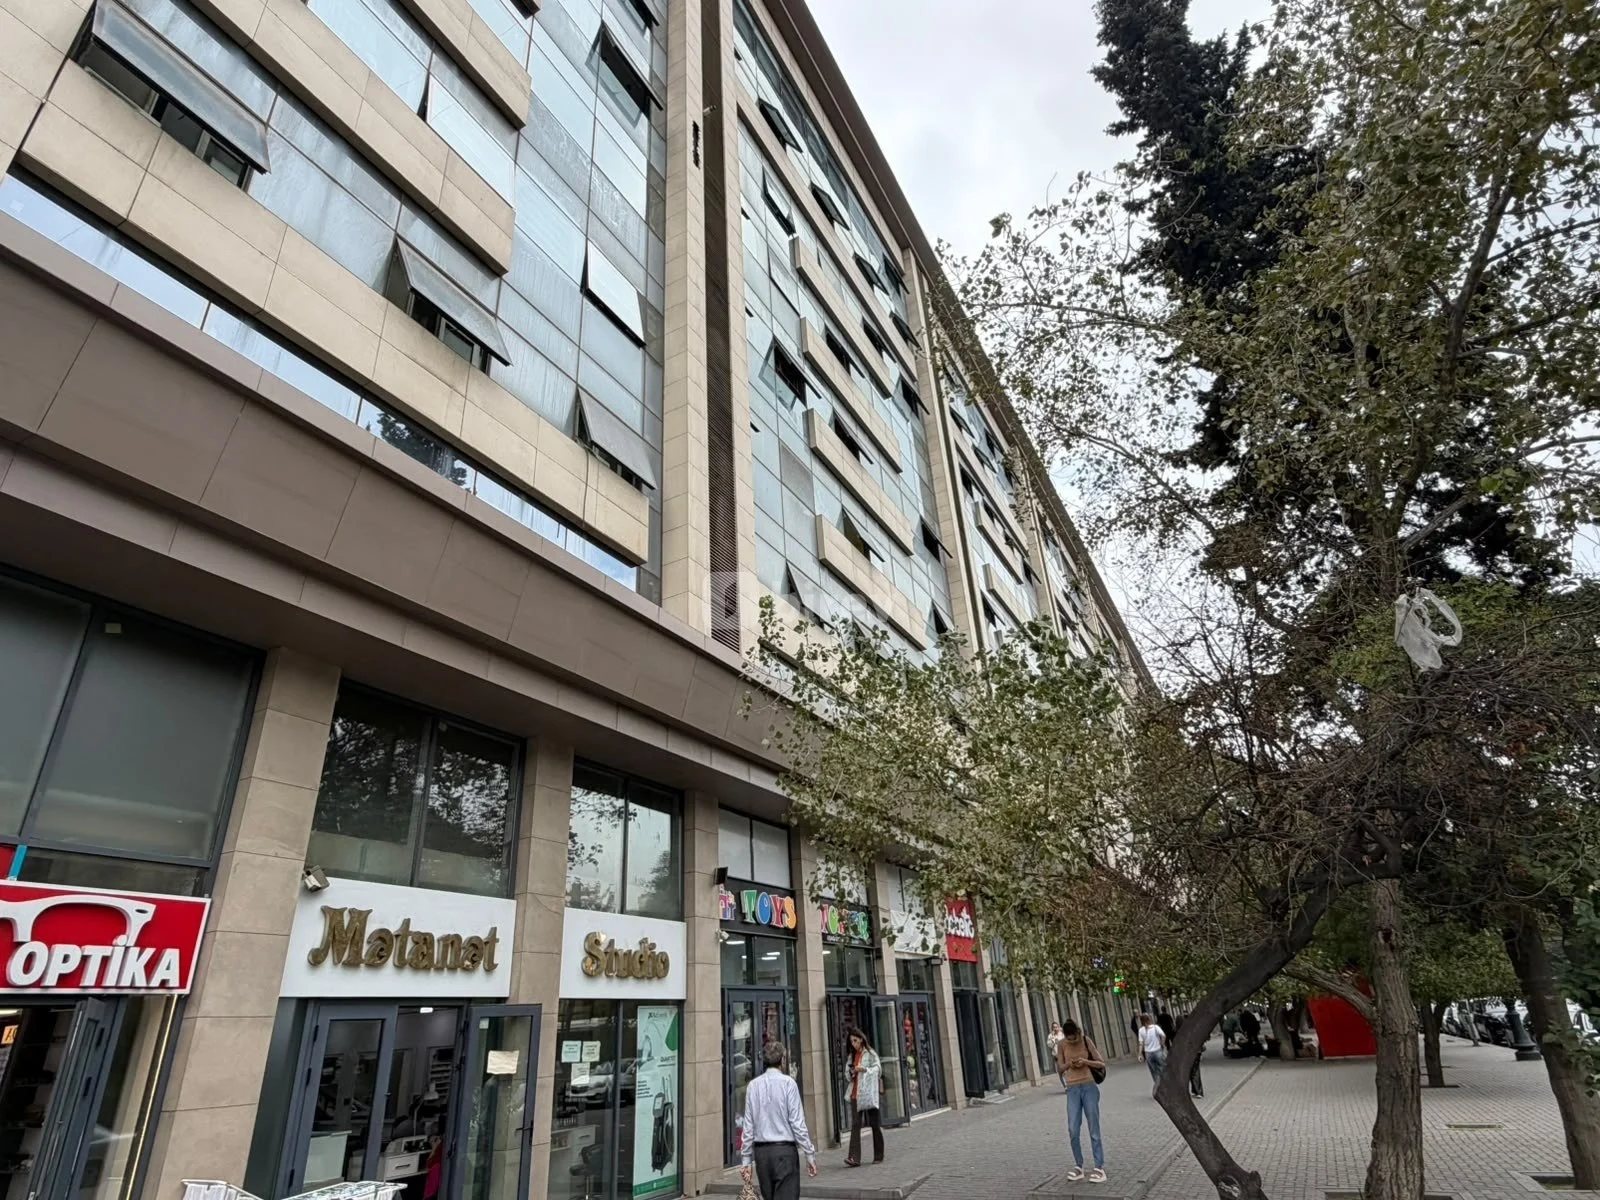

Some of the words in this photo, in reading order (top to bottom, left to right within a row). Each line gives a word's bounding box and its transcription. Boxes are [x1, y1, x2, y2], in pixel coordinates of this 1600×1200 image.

[741, 889, 797, 929] TOYS
[7, 935, 181, 988] OPTİKA
[307, 905, 500, 971] Mətanət
[581, 931, 670, 979] Studio
